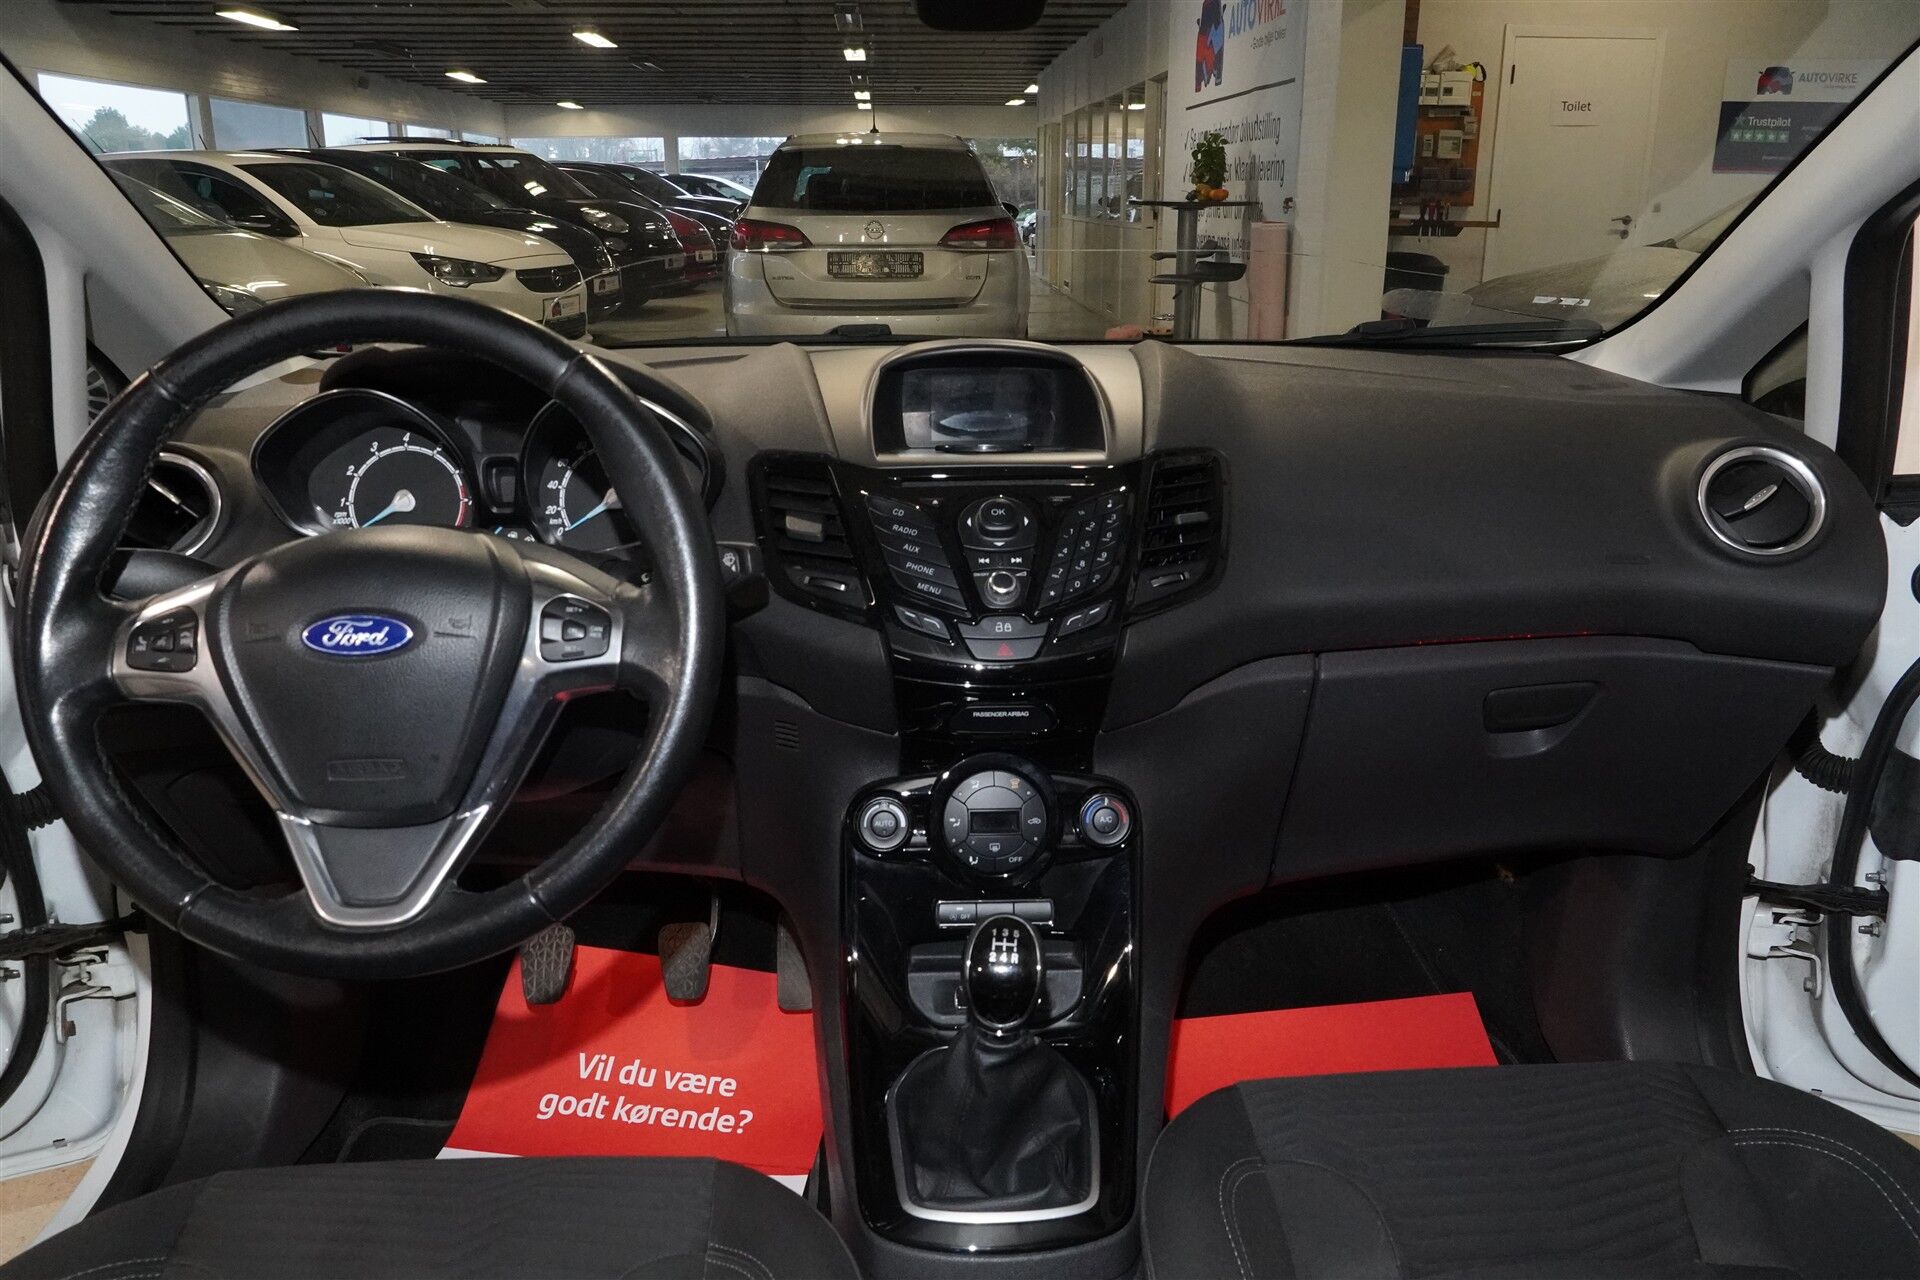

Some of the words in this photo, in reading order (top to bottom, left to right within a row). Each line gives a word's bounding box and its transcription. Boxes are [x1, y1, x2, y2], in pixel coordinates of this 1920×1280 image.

[1798, 72, 1858, 83] AUTOVIRKE
[1561, 100, 1592, 112] Toilet
[1748, 116, 1792, 128] Trustpilot
[403, 432, 411, 441] 4
[370, 441, 379, 453] 3
[346, 465, 355, 476] 2
[547, 480, 559, 489] 40
[340, 496, 346, 507] 1
[545, 505, 557, 515] 20
[892, 508, 905, 517] CD
[991, 508, 1006, 516] OK
[557, 527, 564, 536] 0
[892, 524, 918, 536] RADIO
[903, 543, 920, 554] AUX
[905, 561, 935, 576] PHONE
[917, 582, 942, 595] MENU
[322, 620, 390, 647] Ford
[1002, 928, 1009, 937] 3
[1013, 929, 1020, 938] 5
[988, 951, 997, 963] 2
[999, 951, 1008, 963] 4
[1010, 952, 1019, 965] R
[579, 1052, 616, 1082] Vil
[619, 1059, 657, 1087] du
[665, 1070, 738, 1097] være
[536, 1092, 610, 1120] godt
[612, 1095, 754, 1134] kørende?
